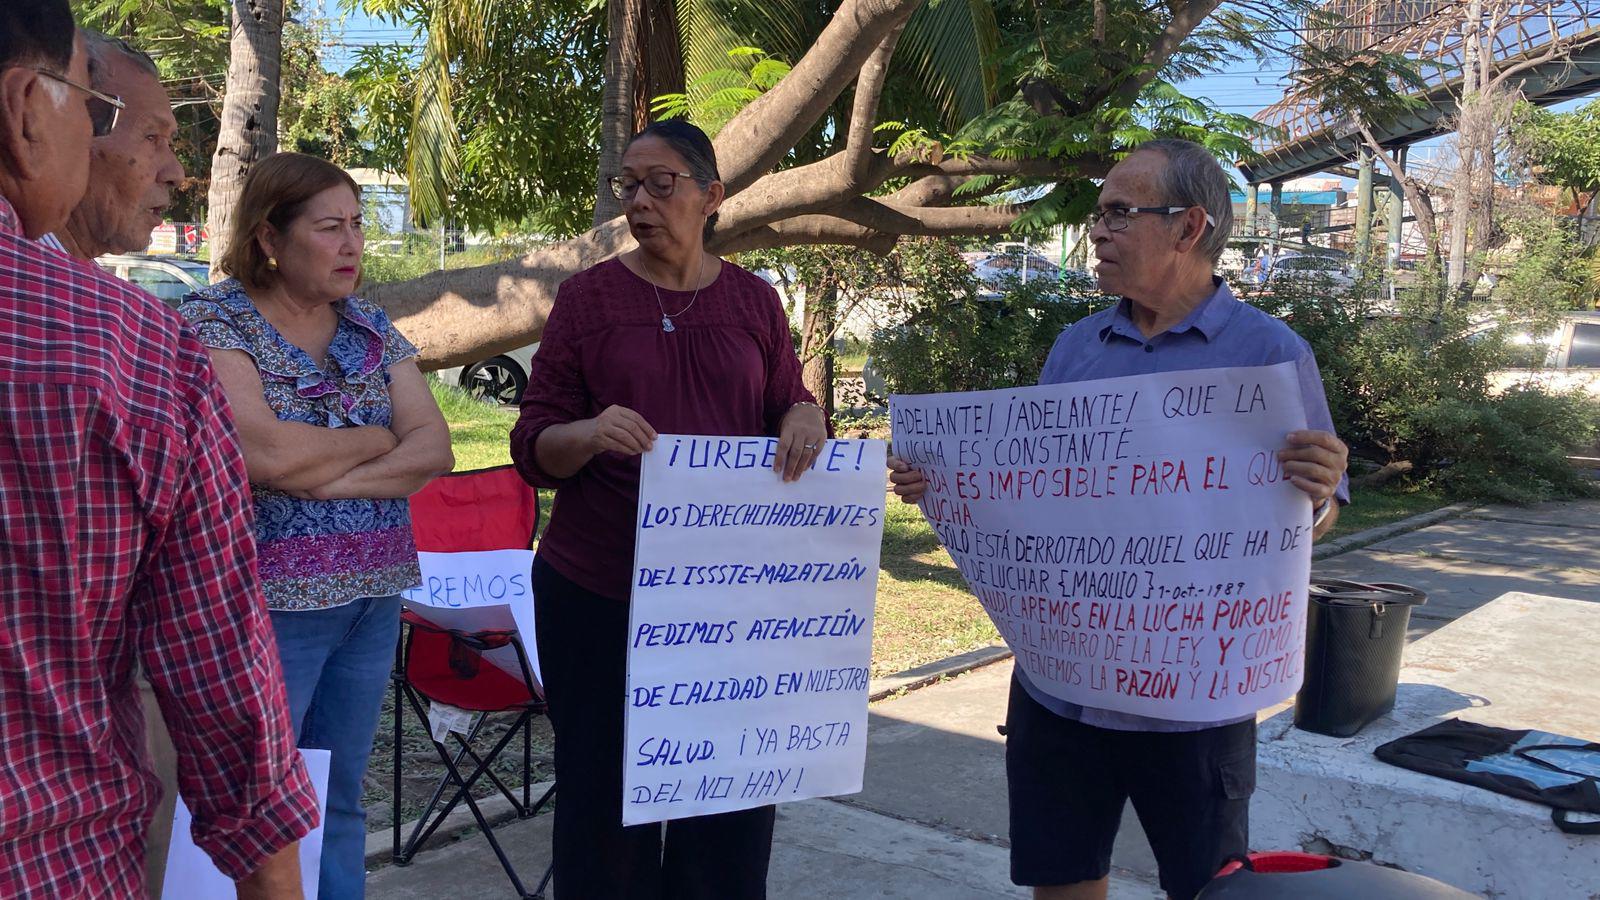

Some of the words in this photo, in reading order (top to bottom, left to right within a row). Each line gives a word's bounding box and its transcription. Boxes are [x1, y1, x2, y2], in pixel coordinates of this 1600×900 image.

[1005, 391, 1138, 436] ¡ADELANTE!
[1163, 386, 1217, 418] QUE
[1235, 384, 1266, 413] LA
[669, 439, 864, 471] ¡URGEE!
[897, 440, 946, 467] LUCHA
[959, 440, 982, 466] ES
[919, 467, 950, 496] ADA
[956, 472, 980, 499] ES
[989, 465, 1118, 499] IMPOSIBLE
[1131, 459, 1190, 495] PARA
[1204, 456, 1229, 489] EL
[642, 504, 680, 528] LOS
[683, 503, 879, 527] DERECHOHABIENTES
[976, 529, 1010, 560] ESTÁ
[1016, 535, 1114, 565] DERROTADO
[1121, 535, 1186, 565] AQUEL
[1195, 532, 1234, 560] QUE
[1243, 530, 1268, 557] HA
[1280, 526, 1310, 551] DE-
[638, 566, 676, 587] DEL
[683, 557, 866, 585] ISSSTE-MAZATLÁN
[971, 559, 987, 584] DE
[990, 563, 1049, 594] LUCHAR
[634, 621, 737, 648] PEDIMOS
[746, 608, 865, 641] ATENCIÓN
[1089, 603, 1111, 630] EN
[1114, 603, 1135, 631] LA
[1143, 601, 1204, 632] LUCHA
[1213, 591, 1292, 631] PORQUE
[1022, 622, 1037, 647] AL
[1040, 625, 1099, 658] AMPARO
[1104, 633, 1125, 661] DE
[1131, 634, 1155, 663] LA
[1161, 635, 1204, 668] LEY,
[1218, 636, 1235, 665] Y
[1243, 621, 1292, 660] COMO
[633, 685, 665, 707] DE
[669, 675, 768, 705] CALIDAD
[775, 672, 802, 695] EN
[805, 667, 868, 692] NUESTRA
[1021, 648, 1082, 686] TENEMOS
[1091, 664, 1107, 690] LA
[1116, 667, 1180, 699] RAZÓN
[1189, 670, 1201, 699] Y
[1208, 670, 1229, 699] LA
[637, 737, 715, 766] SALUD.
[786, 722, 850, 750] BASTA
[631, 779, 683, 803] DEL
[695, 775, 733, 800] NO
